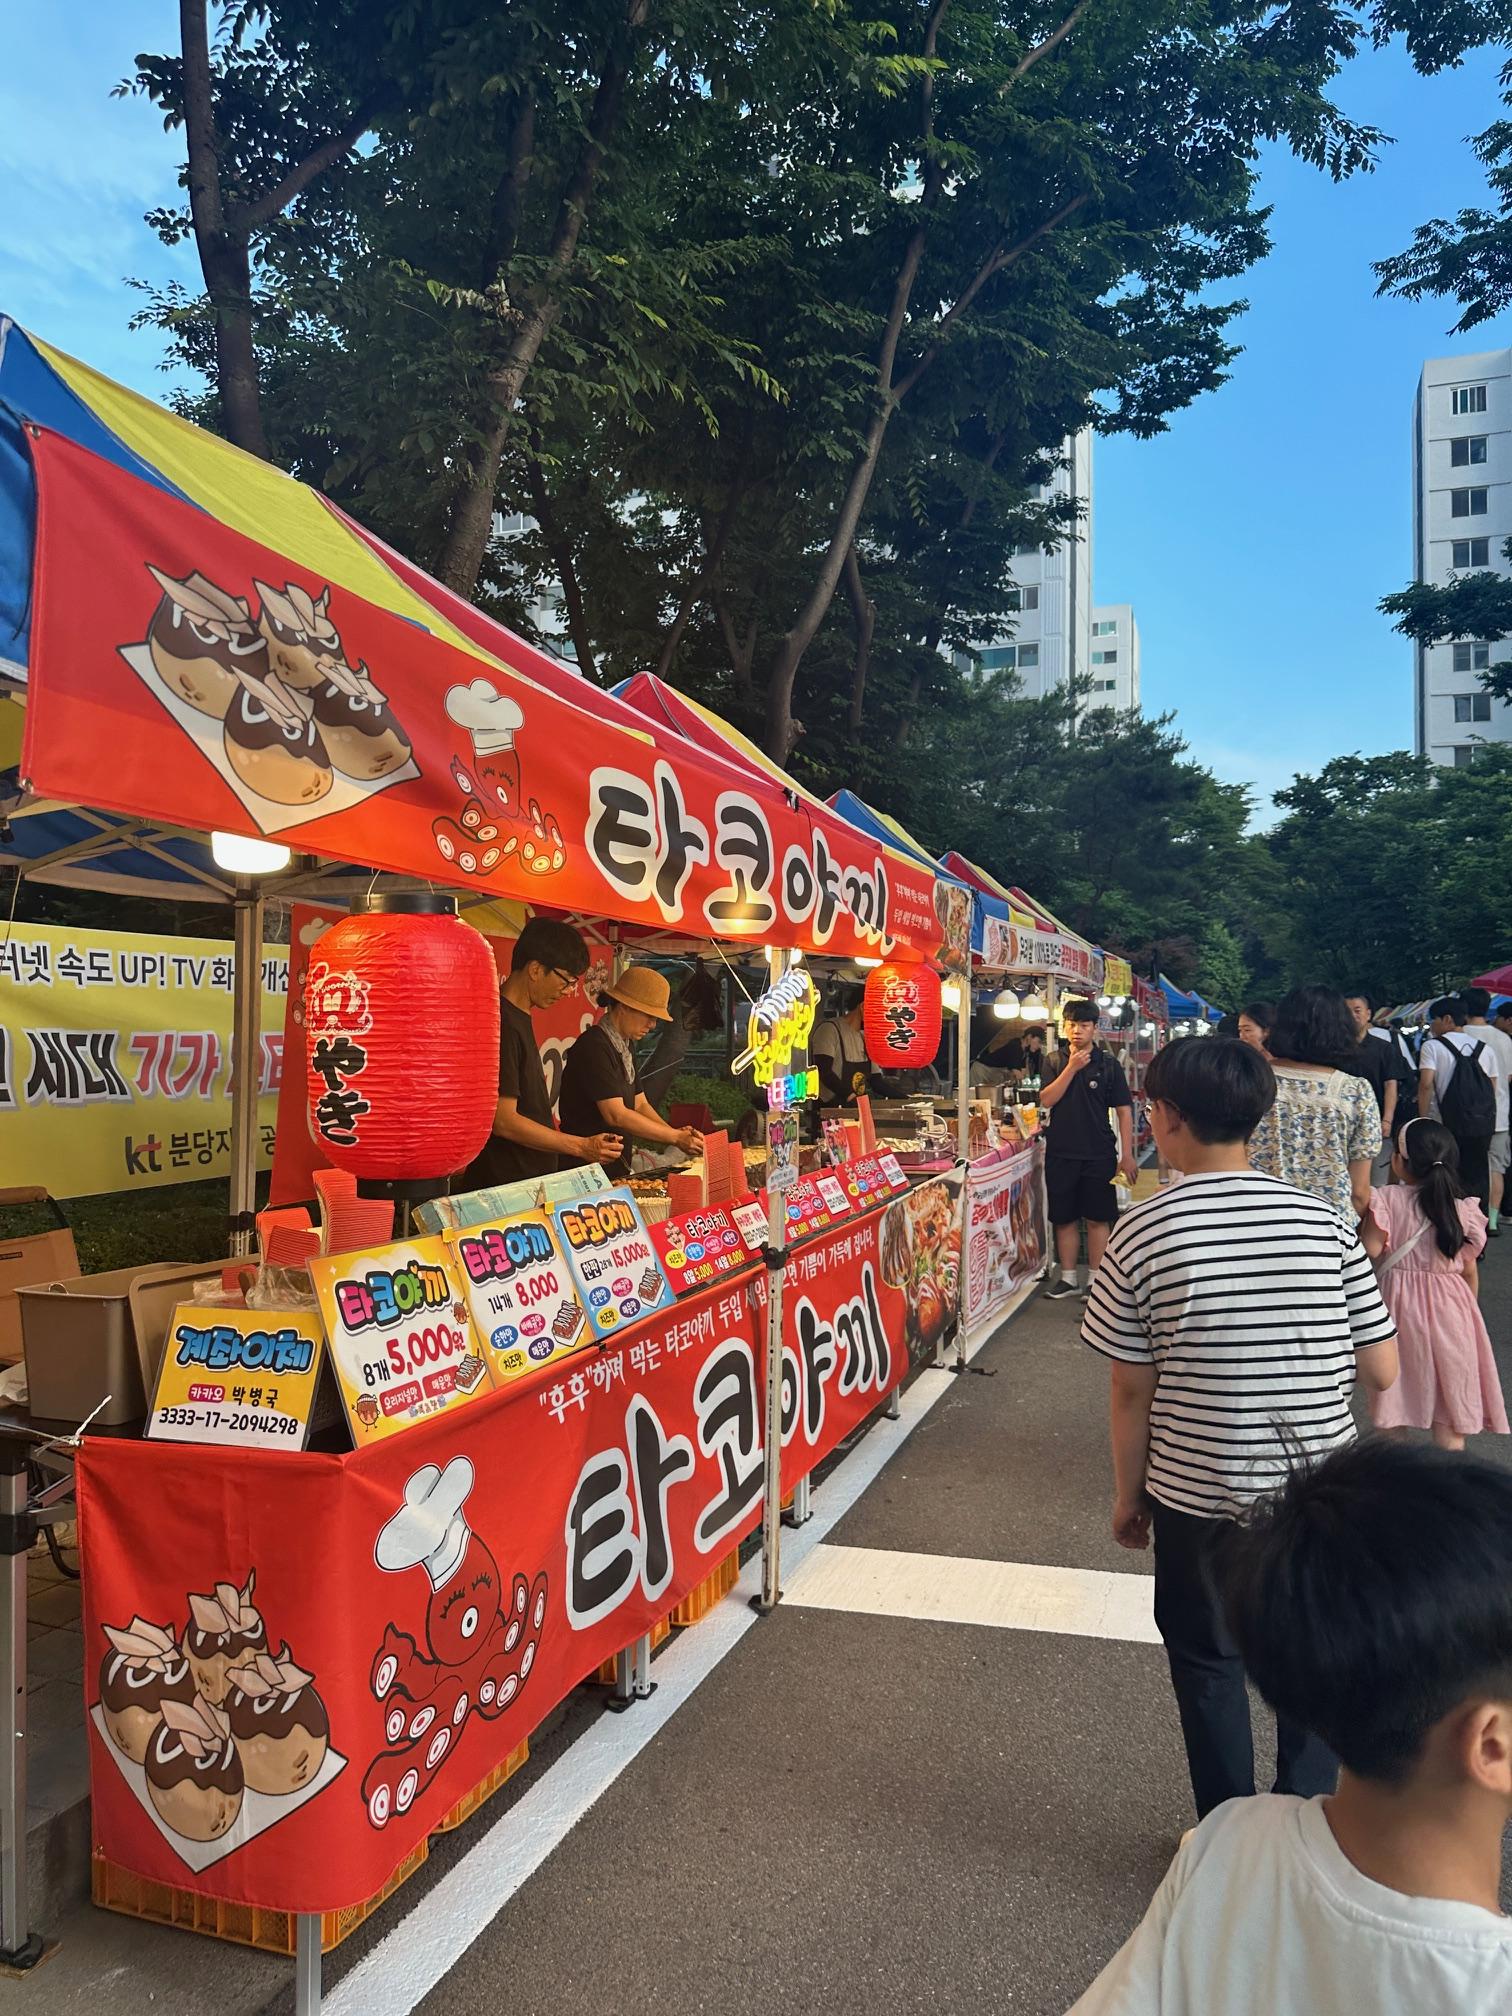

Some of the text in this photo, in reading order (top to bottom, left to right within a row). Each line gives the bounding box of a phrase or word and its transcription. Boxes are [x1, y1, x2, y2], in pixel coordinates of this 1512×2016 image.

[585, 760, 895, 955] 타코야끼
[58, 947, 113, 985] 속도
[121, 954, 164, 985] UP!
[169, 958, 205, 985] TV
[26, 1031, 128, 1099] 세대
[131, 1032, 222, 1098] 기가
[125, 1134, 162, 1175] kt
[561, 1199, 637, 1250] 타코야끼
[686, 1209, 730, 1238] 타코야끼
[459, 1223, 556, 1282] 타코야끼
[582, 1261, 601, 1279] 한판
[336, 1261, 450, 1332] 타코야끼
[488, 1271, 558, 1314] 14개 8,000
[629, 1338, 662, 1376] 먹는
[664, 1307, 716, 1359] 타코야끼
[719, 1290, 743, 1329] 두입
[829, 1236, 852, 1268] 가득해
[176, 1325, 315, 1375] 계좌이체
[363, 1323, 466, 1387] 8개 5,000원
[494, 1327, 515, 1347] 순한맛
[531, 1339, 551, 1356] 매운맛
[503, 1352, 523, 1369] 치즈맛
[189, 1386, 224, 1401] 카카오
[384, 1386, 418, 1410] 오리지널맛
[431, 1373, 452, 1390] 매운맛
[159, 1407, 298, 1435] 3333-17-2094298
[566, 1262, 895, 1630] 타코야끼
